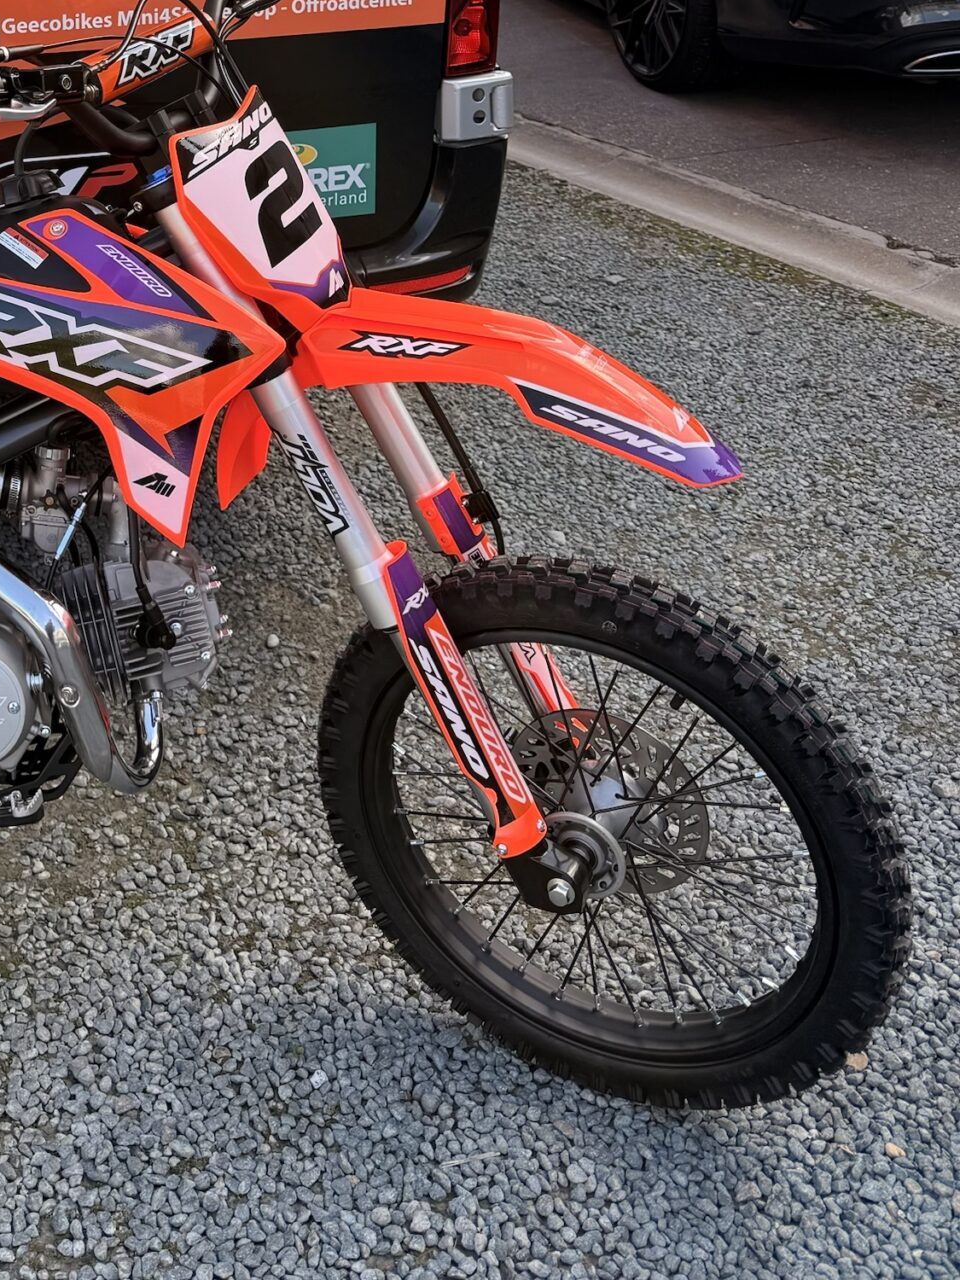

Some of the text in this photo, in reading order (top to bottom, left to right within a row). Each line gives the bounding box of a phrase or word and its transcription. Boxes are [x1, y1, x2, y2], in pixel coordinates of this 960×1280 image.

[1, 11, 112, 35] Geecobikes
[187, 100, 273, 179] SANO
[244, 140, 323, 269] 2
[307, 163, 367, 193] REX
[320, 189, 368, 208] erland
[96, 243, 173, 299] ENDURO
[349, 334, 461, 356] RXF
[539, 403, 687, 463] SANO
[402, 581, 430, 616] RX
[408, 637, 491, 780] SANO
[427, 626, 527, 805] ENDURO
